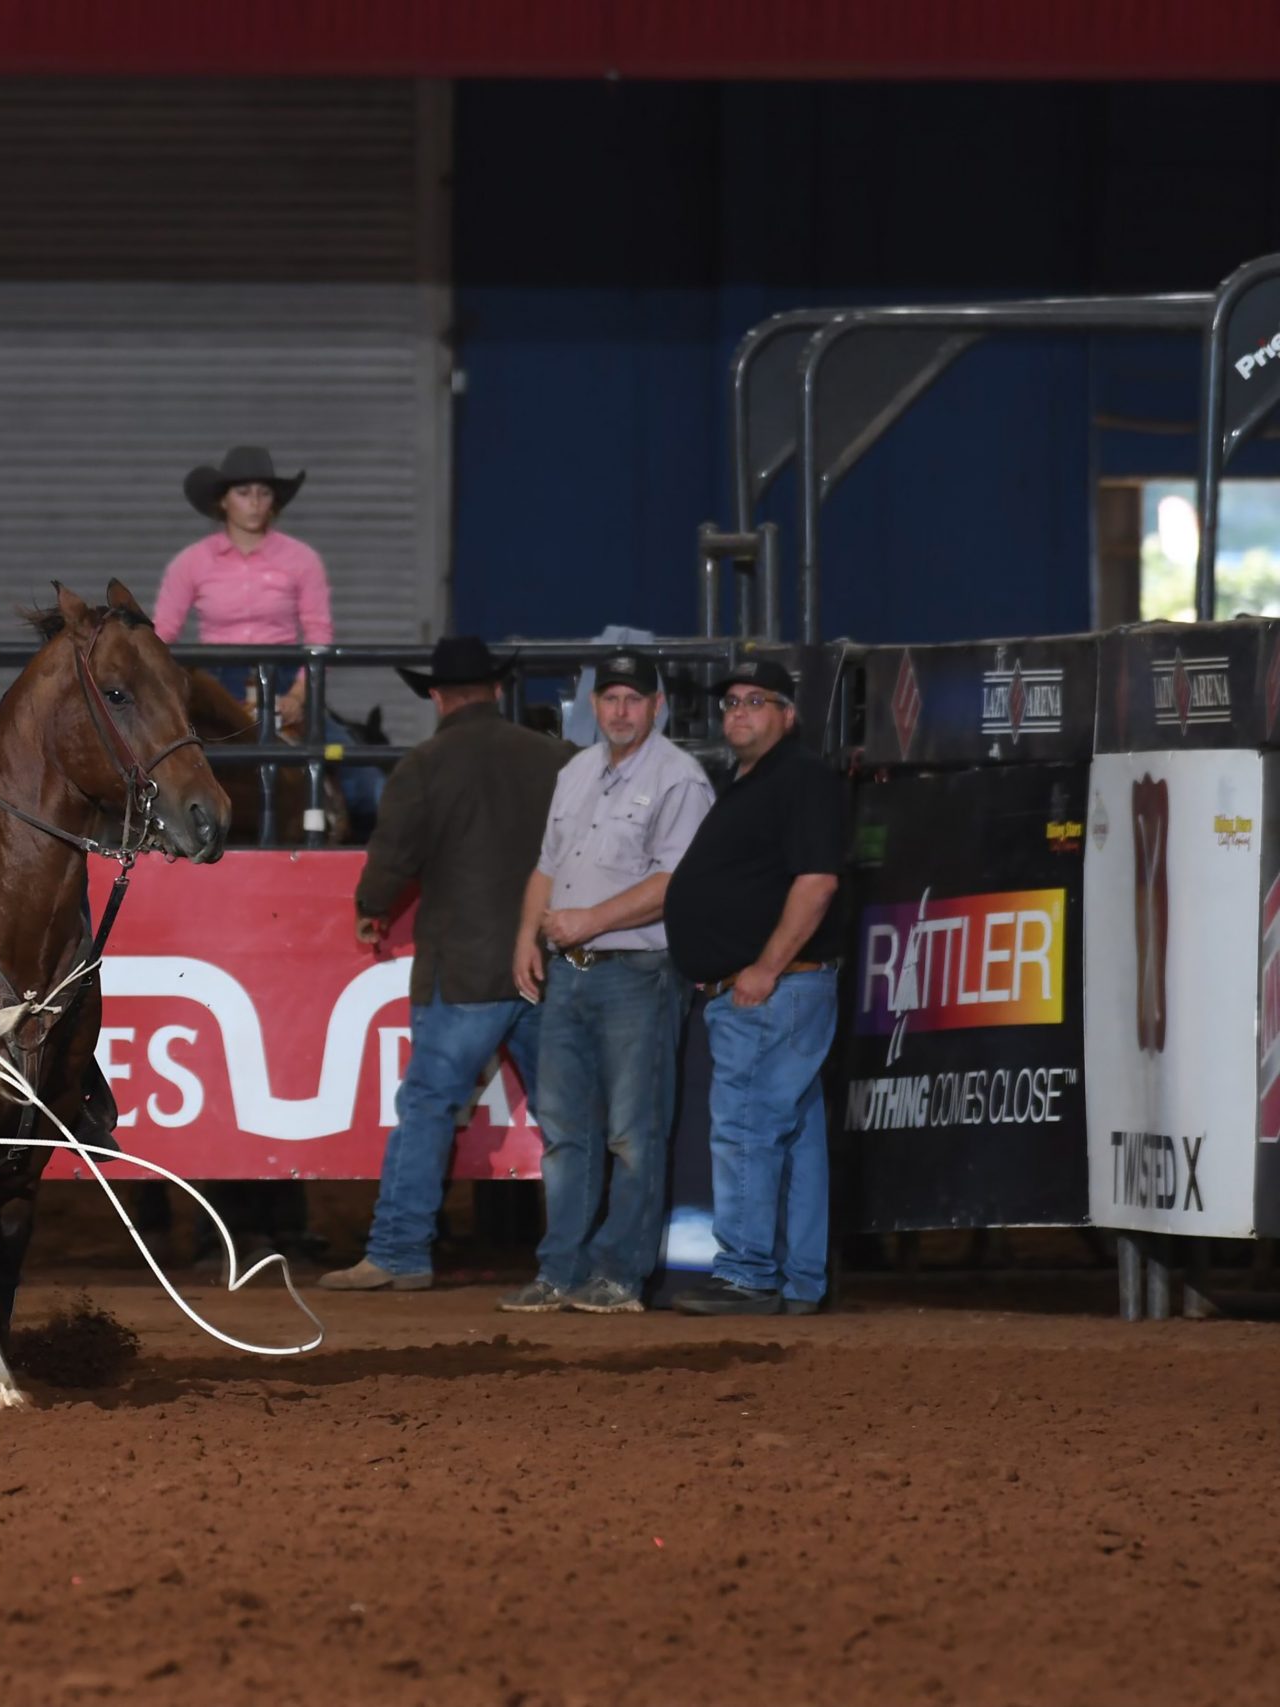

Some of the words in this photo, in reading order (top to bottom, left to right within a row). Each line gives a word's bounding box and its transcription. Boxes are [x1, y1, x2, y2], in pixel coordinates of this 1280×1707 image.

[1026, 686, 1062, 717] ARENA
[1192, 673, 1230, 707] ARENA
[861, 909, 1053, 1016] RATTLER
[94, 1024, 205, 1128] ES
[844, 1074, 930, 1131] NOTHING
[930, 1069, 987, 1128] COMES
[1111, 1131, 1177, 1210] TWISTED
[1182, 1136, 1204, 1212] X
